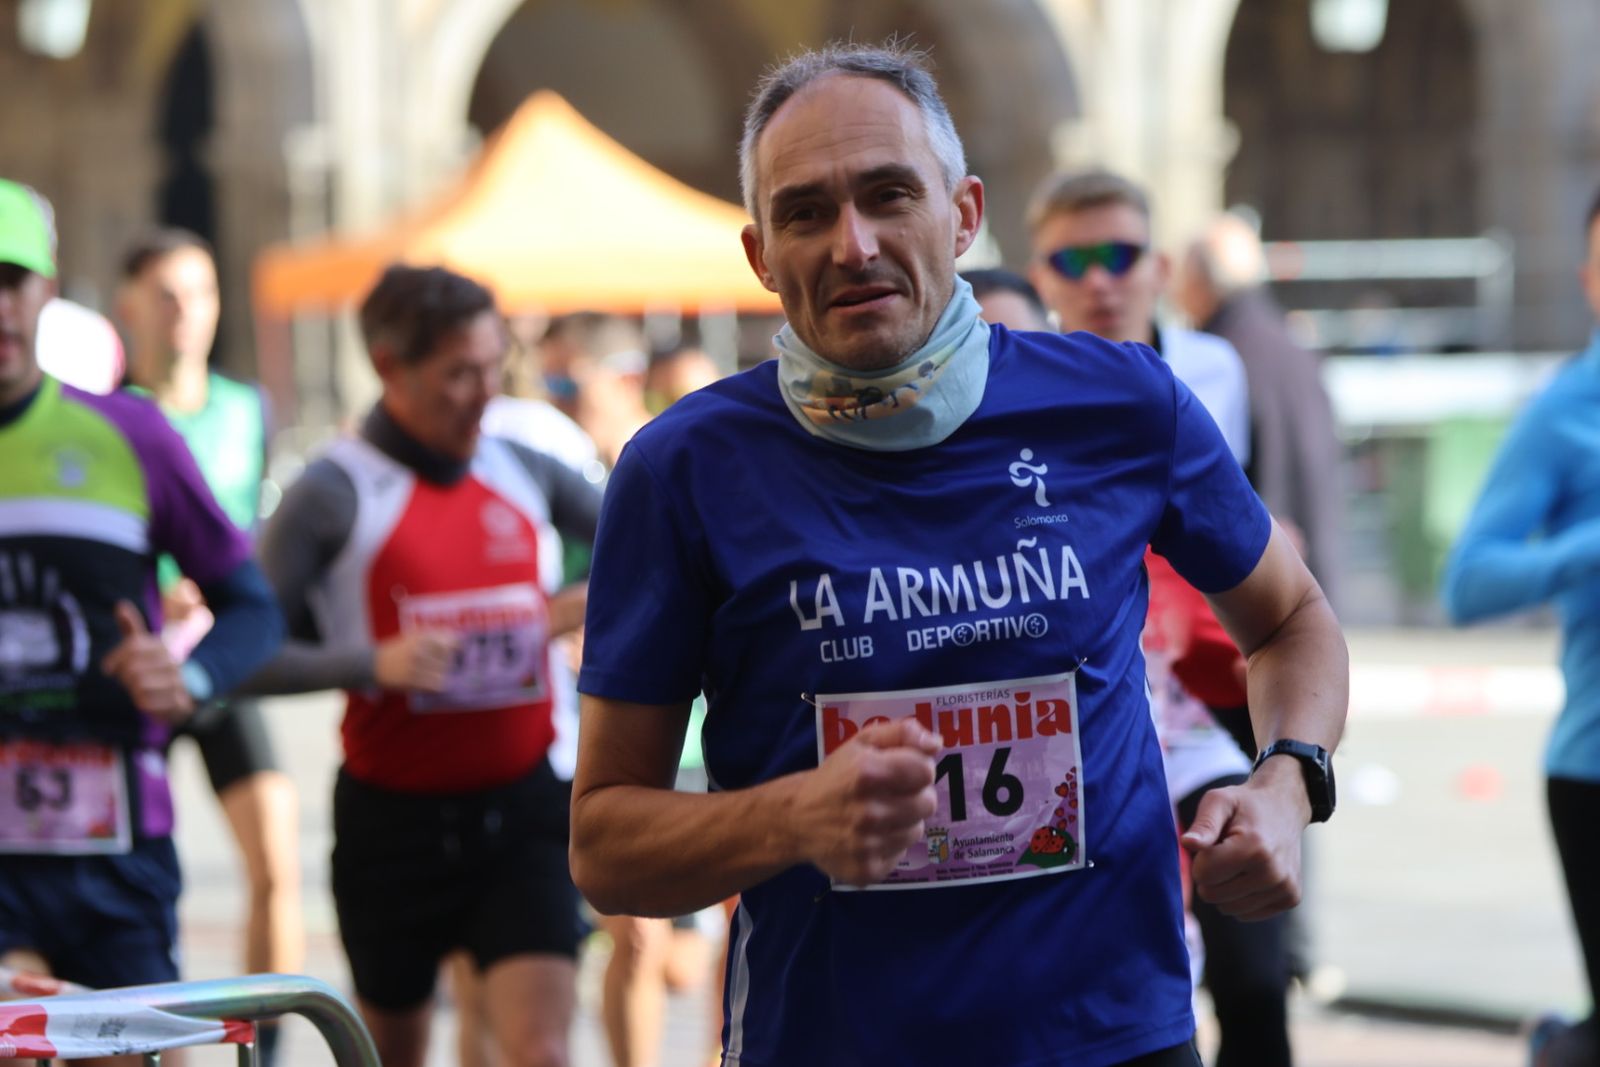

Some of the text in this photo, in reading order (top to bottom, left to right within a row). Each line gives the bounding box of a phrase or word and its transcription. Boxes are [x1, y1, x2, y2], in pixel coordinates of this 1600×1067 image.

[1014, 514, 1068, 529] Salamanca
[790, 537, 1090, 631] LA ARMUÑA
[820, 612, 1048, 663] CLUB DEPORTIVO
[936, 689, 1010, 706] FLORISTERÍAS
[953, 832, 1015, 848] Ayuntamiento
[953, 845, 1016, 860] de Salamanca
